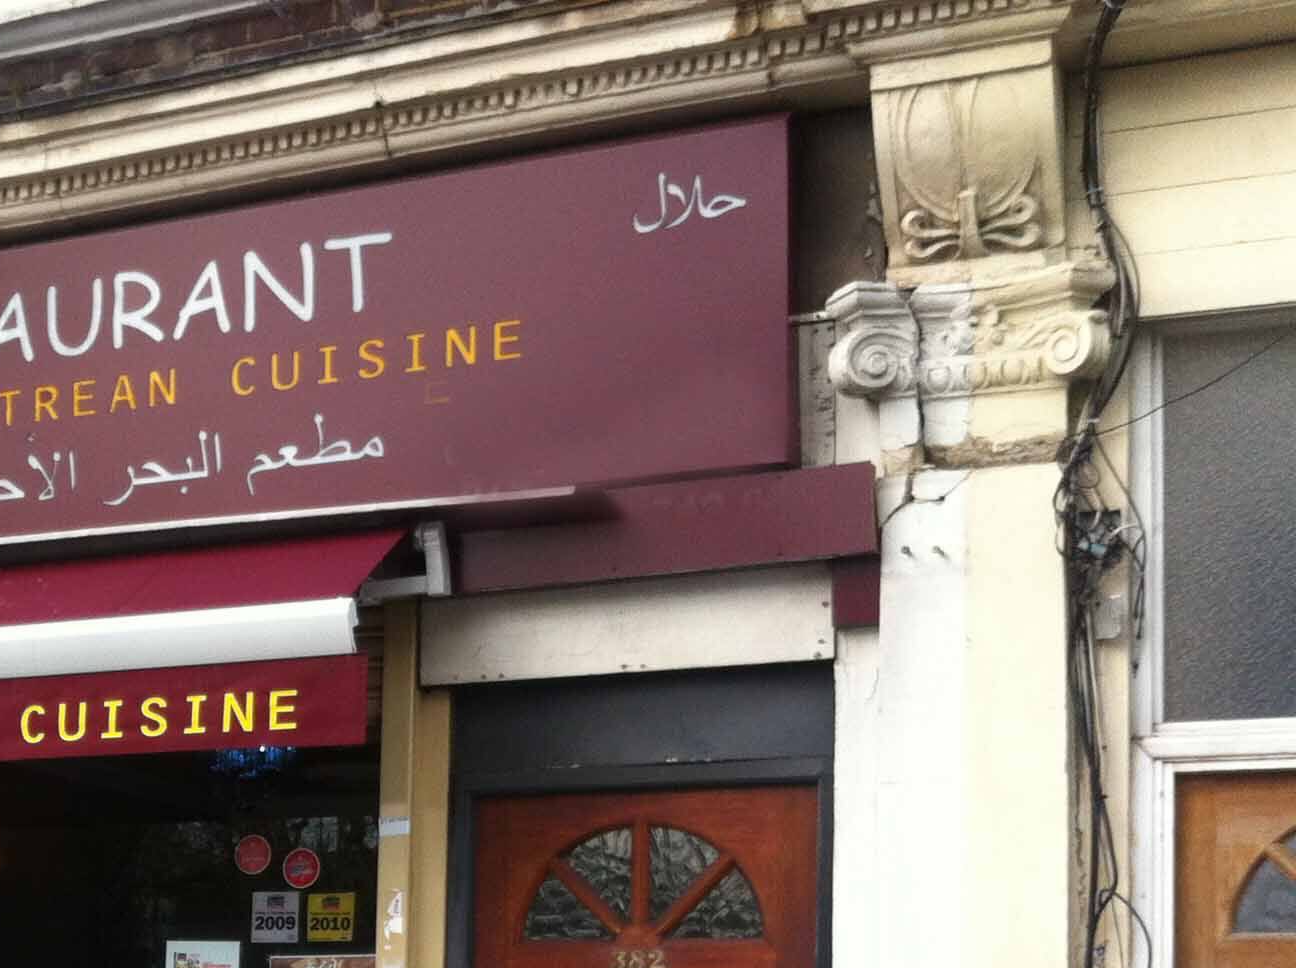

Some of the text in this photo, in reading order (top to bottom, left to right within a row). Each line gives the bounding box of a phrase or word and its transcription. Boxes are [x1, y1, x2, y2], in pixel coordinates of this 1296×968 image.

[632, 172, 747, 234] حلال
[231, 320, 522, 396] CUISINE
[104, 430, 223, 507] البحر
[246, 413, 385, 496] مطعم
[19, 689, 299, 745] CUISINE
[254, 915, 296, 931] 2009
[310, 916, 352, 931] 2010
